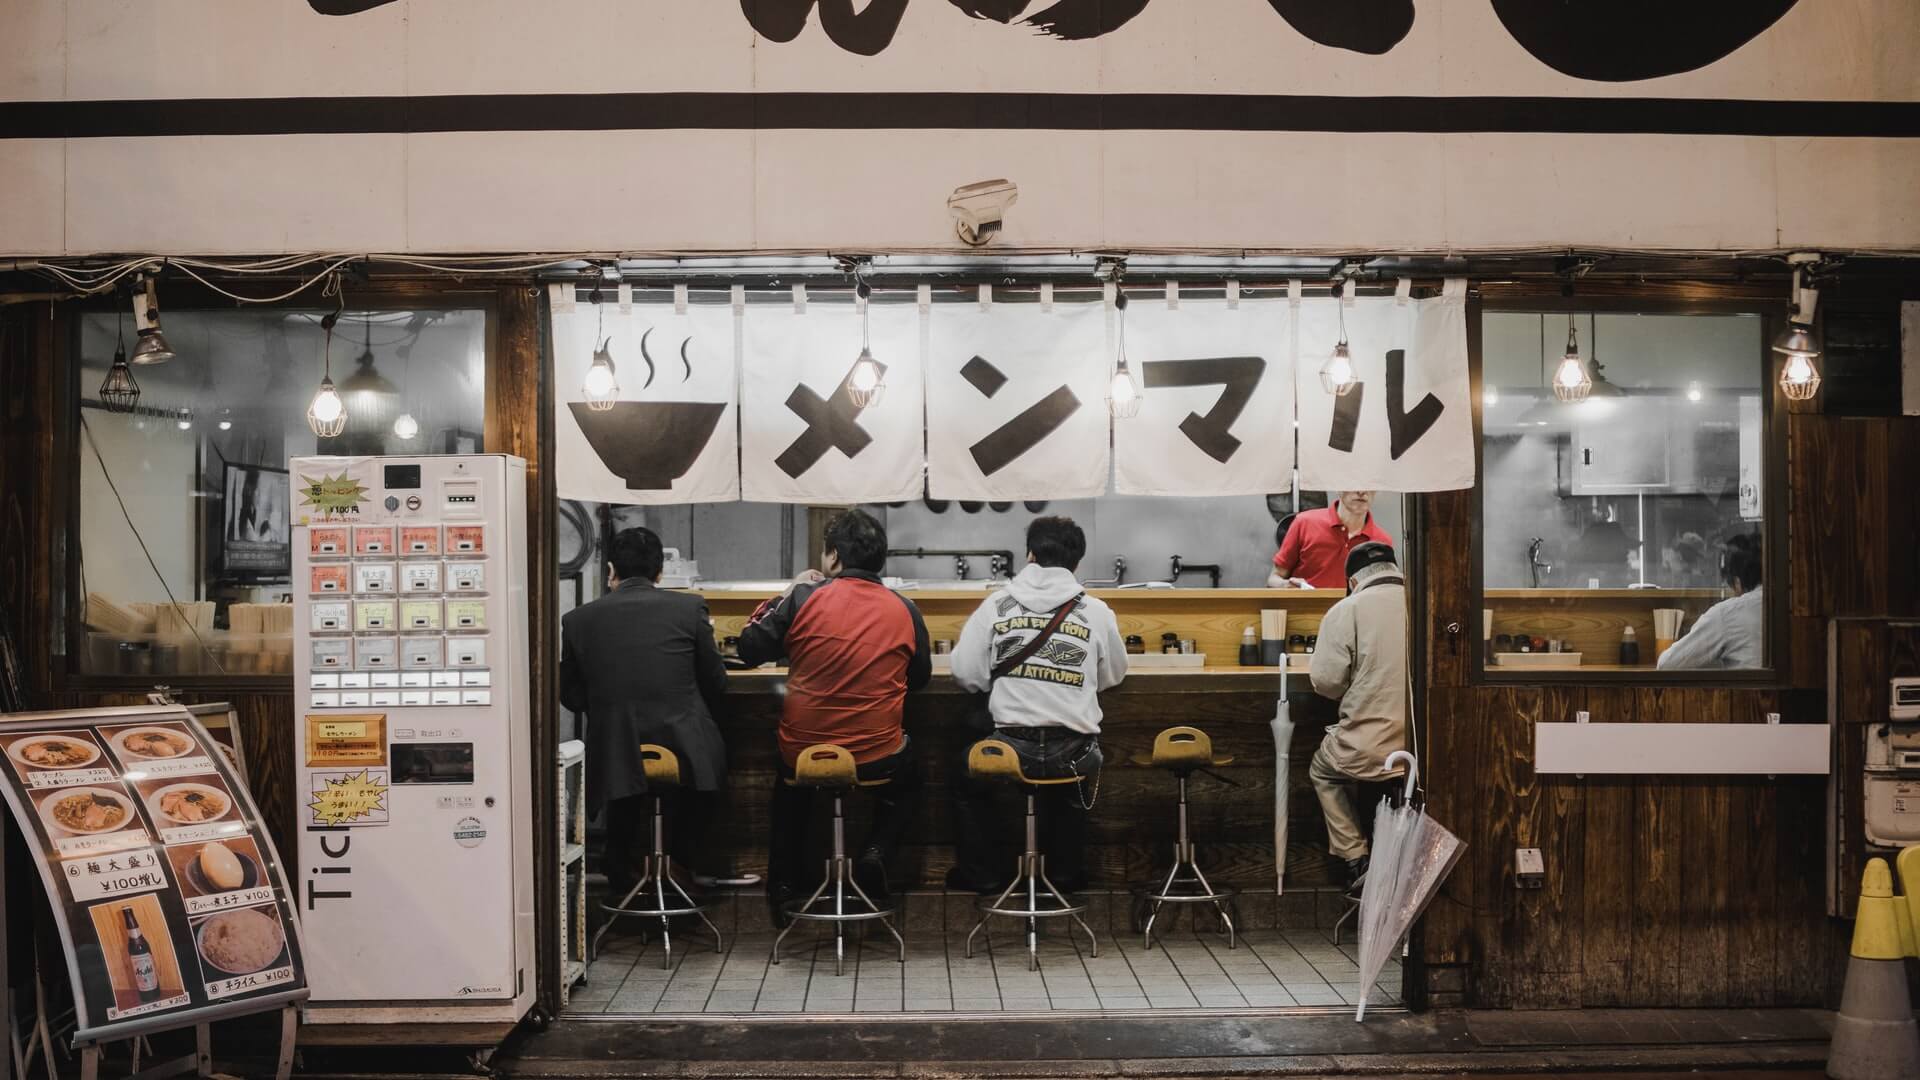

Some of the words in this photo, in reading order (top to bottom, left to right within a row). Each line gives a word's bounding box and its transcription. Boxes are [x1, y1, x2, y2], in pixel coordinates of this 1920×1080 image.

[775, 348, 1445, 479] メンマル
[1009, 616, 1028, 629] AN
[87, 854, 155, 875] 麺大盛り
[100, 872, 162, 891] ¥100増し
[246, 890, 270, 901] ¥100
[265, 969, 290, 982] ¥100
